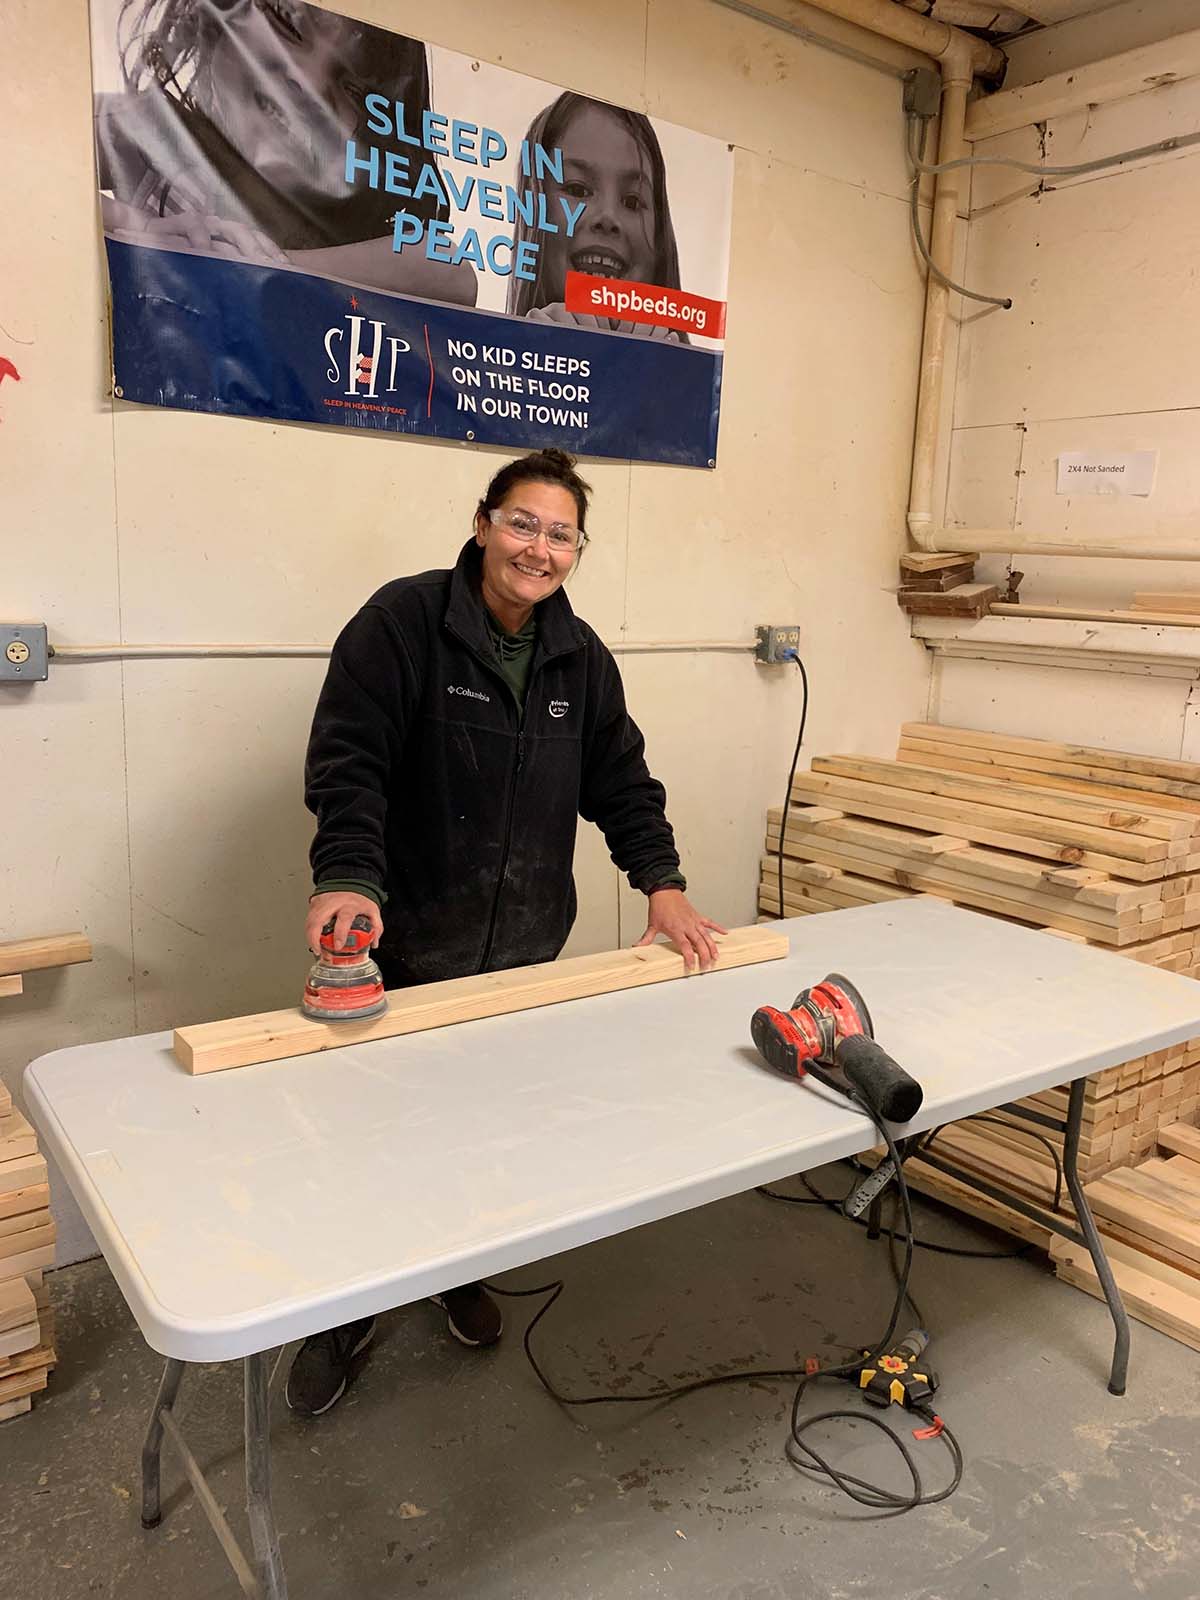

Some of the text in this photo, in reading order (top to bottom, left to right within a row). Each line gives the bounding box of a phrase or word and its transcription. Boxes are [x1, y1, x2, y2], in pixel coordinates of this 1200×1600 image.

[365, 93, 564, 184] SLEEP IN
[345, 140, 586, 238] HEAVENLY
[392, 211, 540, 281] PEACE
[590, 286, 706, 329] shpbeds.org
[447, 338, 591, 377] NO KID SLEEPS
[451, 366, 590, 403] ON THE FLOOR
[323, 399, 344, 407] SLEEP
[352, 402, 385, 412] HEAVENLY
[386, 407, 407, 415] PEACE
[457, 392, 589, 429] IN OUR TOWN!
[1067, 464, 1126, 473] 2X4 Not Sanded
[456, 686, 490, 702] Columbia
